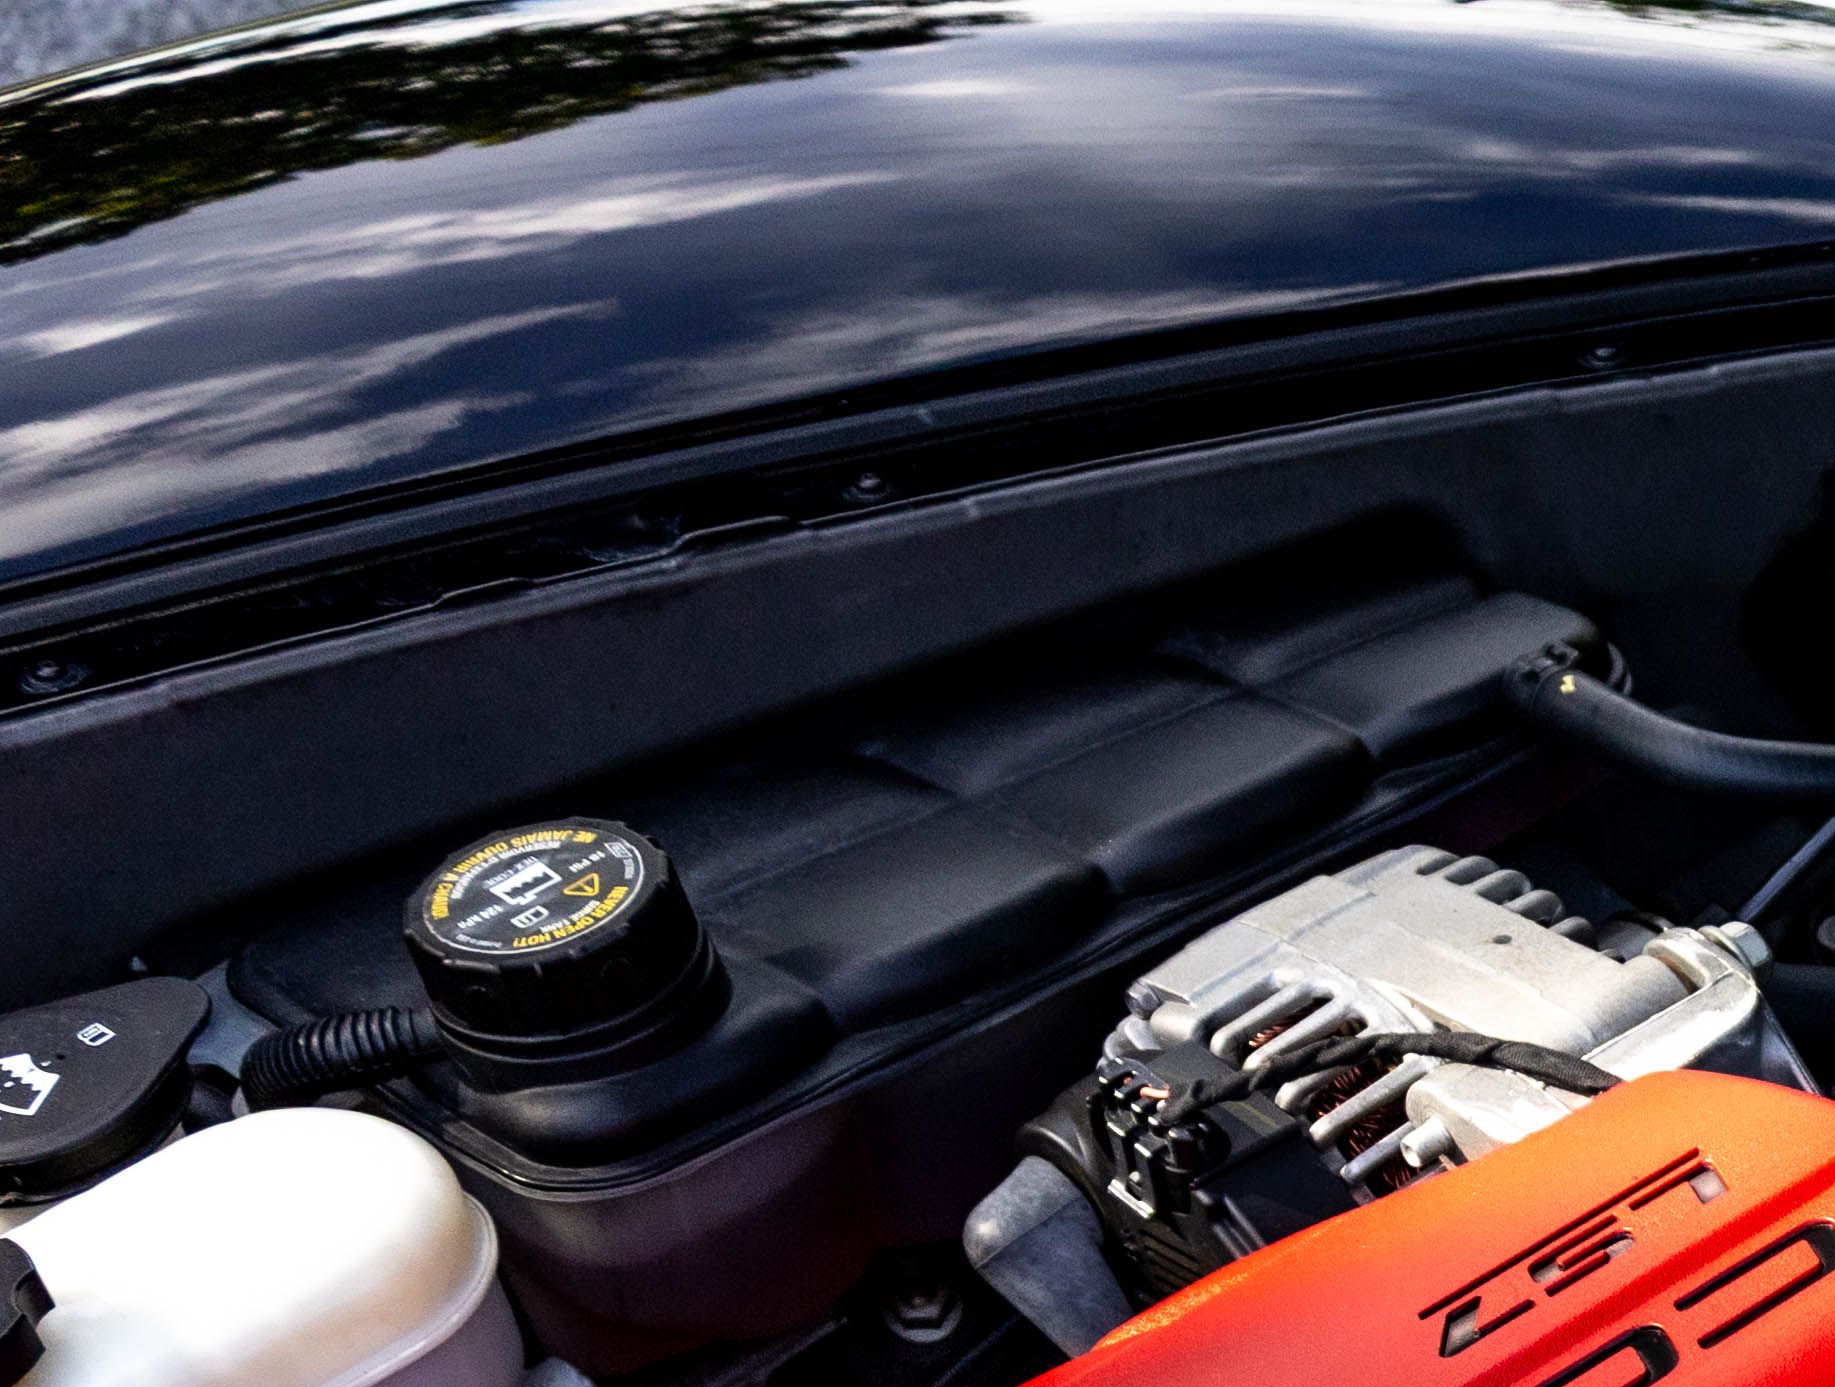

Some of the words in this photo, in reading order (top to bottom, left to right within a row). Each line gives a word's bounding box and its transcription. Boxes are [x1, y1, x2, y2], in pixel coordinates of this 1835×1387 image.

[510, 829, 572, 848] JAMAIS
[572, 830, 597, 844] NE
[454, 841, 509, 874] OUVRIR
[592, 885, 629, 925] NEVER
[553, 915, 595, 940] OPEN
[1418, 1147, 1728, 1358] LS7
